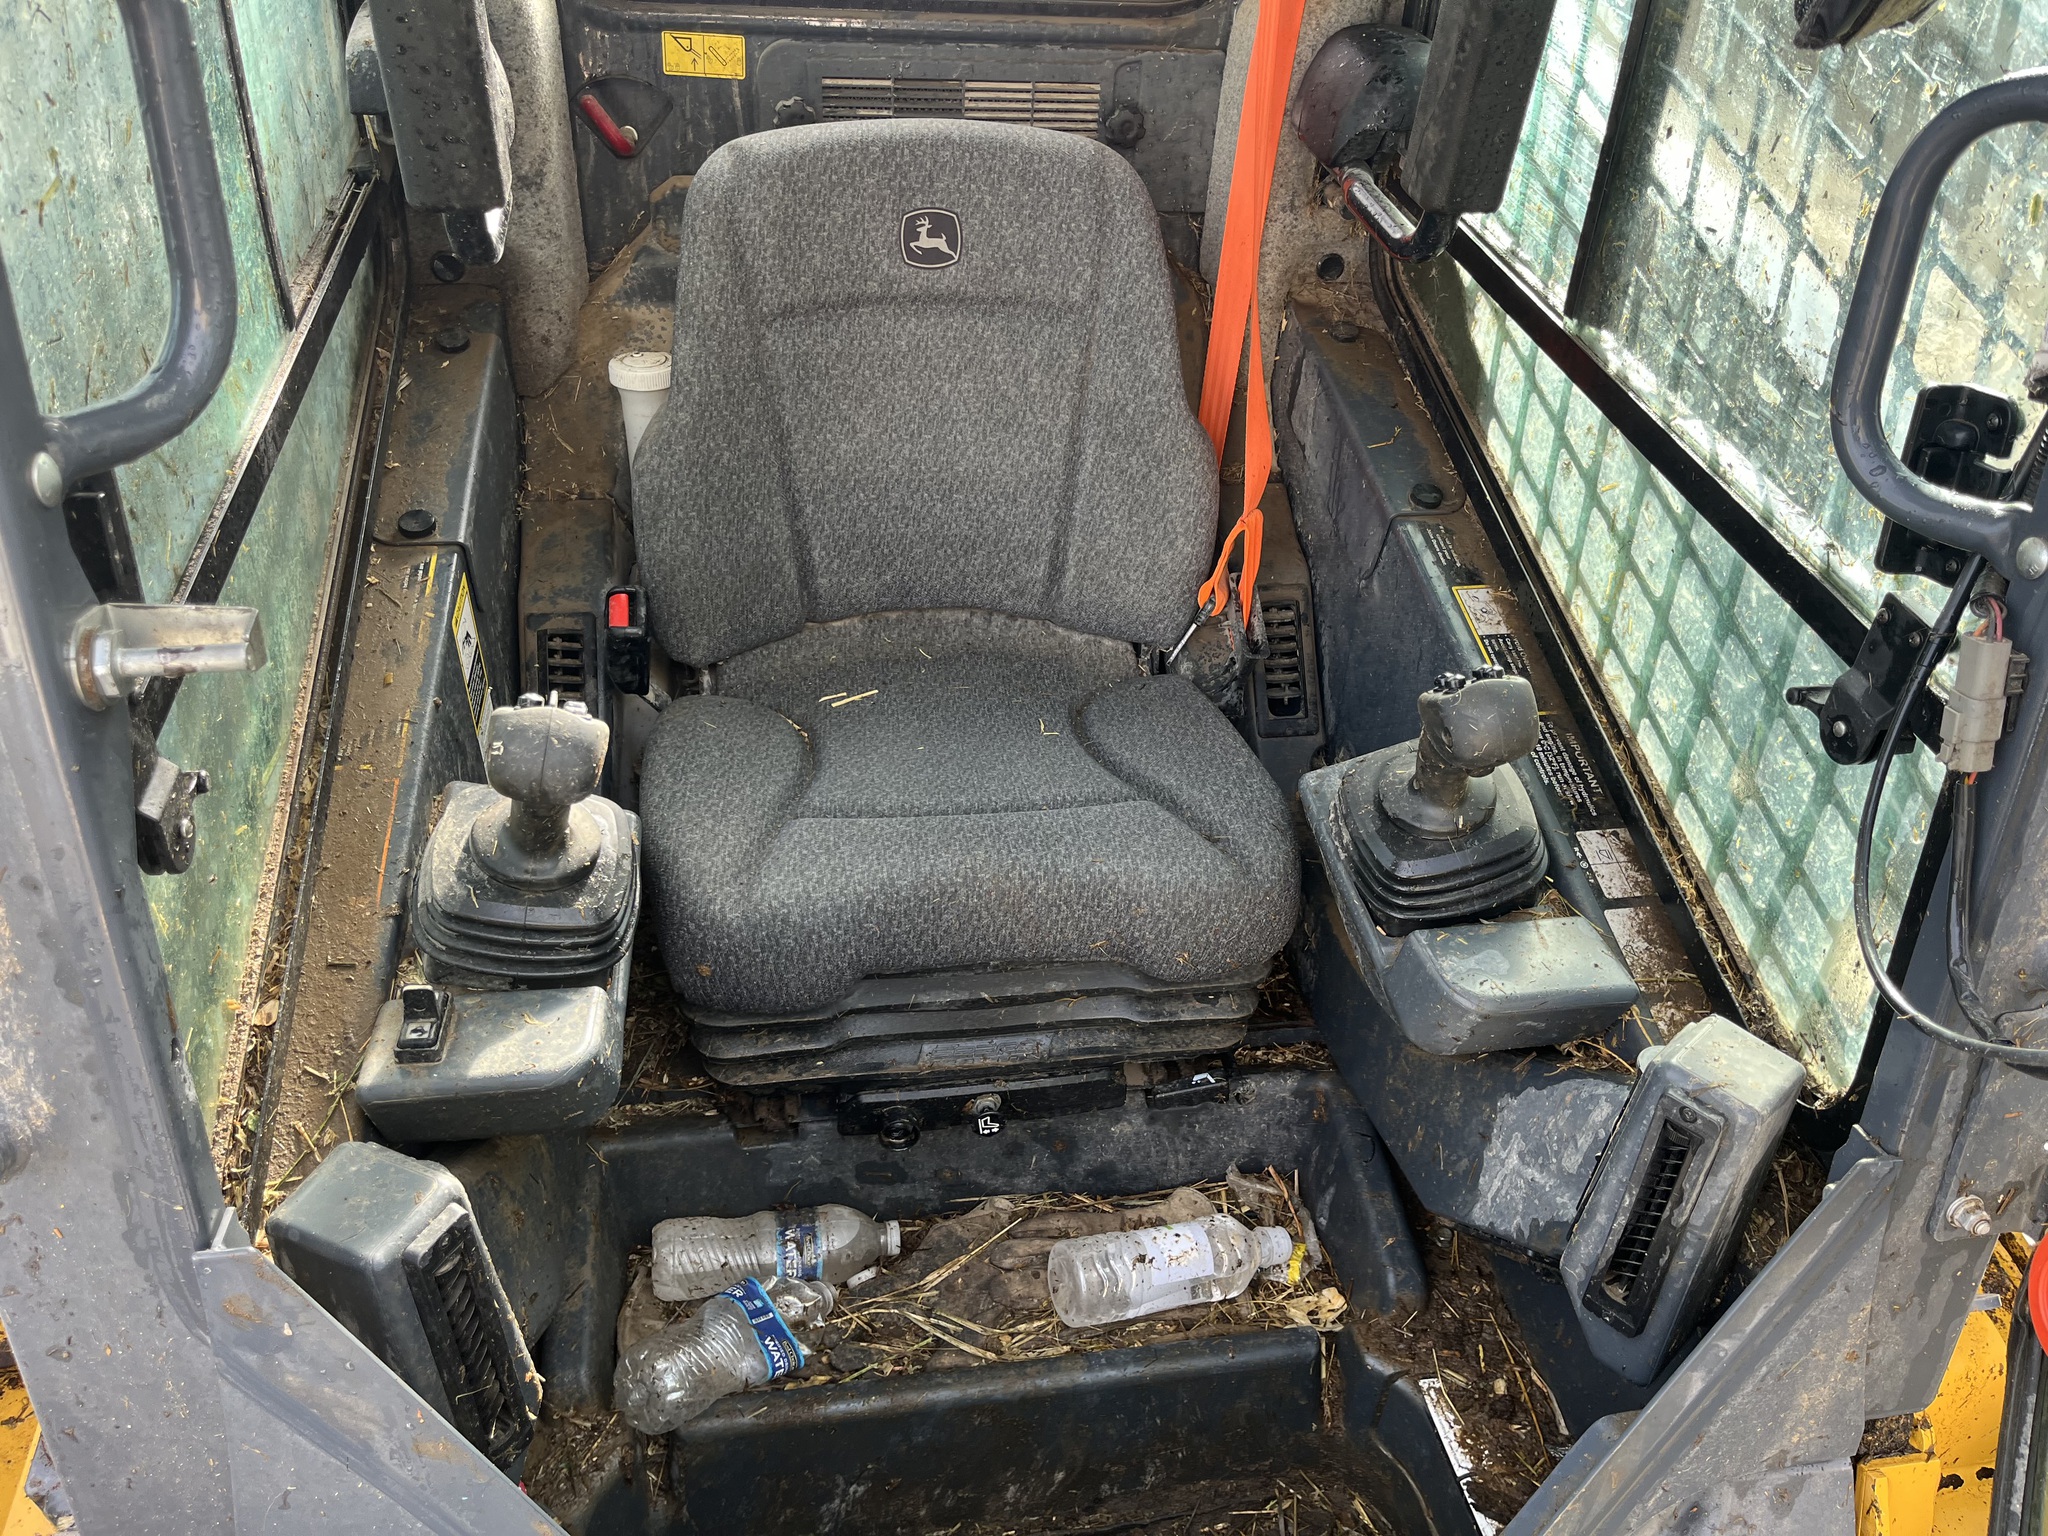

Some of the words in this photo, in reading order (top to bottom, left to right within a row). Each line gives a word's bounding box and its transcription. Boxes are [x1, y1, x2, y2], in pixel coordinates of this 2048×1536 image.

[1511, 634, 1524, 651] void
[1538, 751, 1553, 776] minutes
[1562, 752, 1577, 776] damage
[1566, 732, 1604, 796] IMPORTANT
[1556, 771, 1564, 783] run
[784, 1228, 796, 1278] WATER
[764, 1336, 784, 1380] WATE
